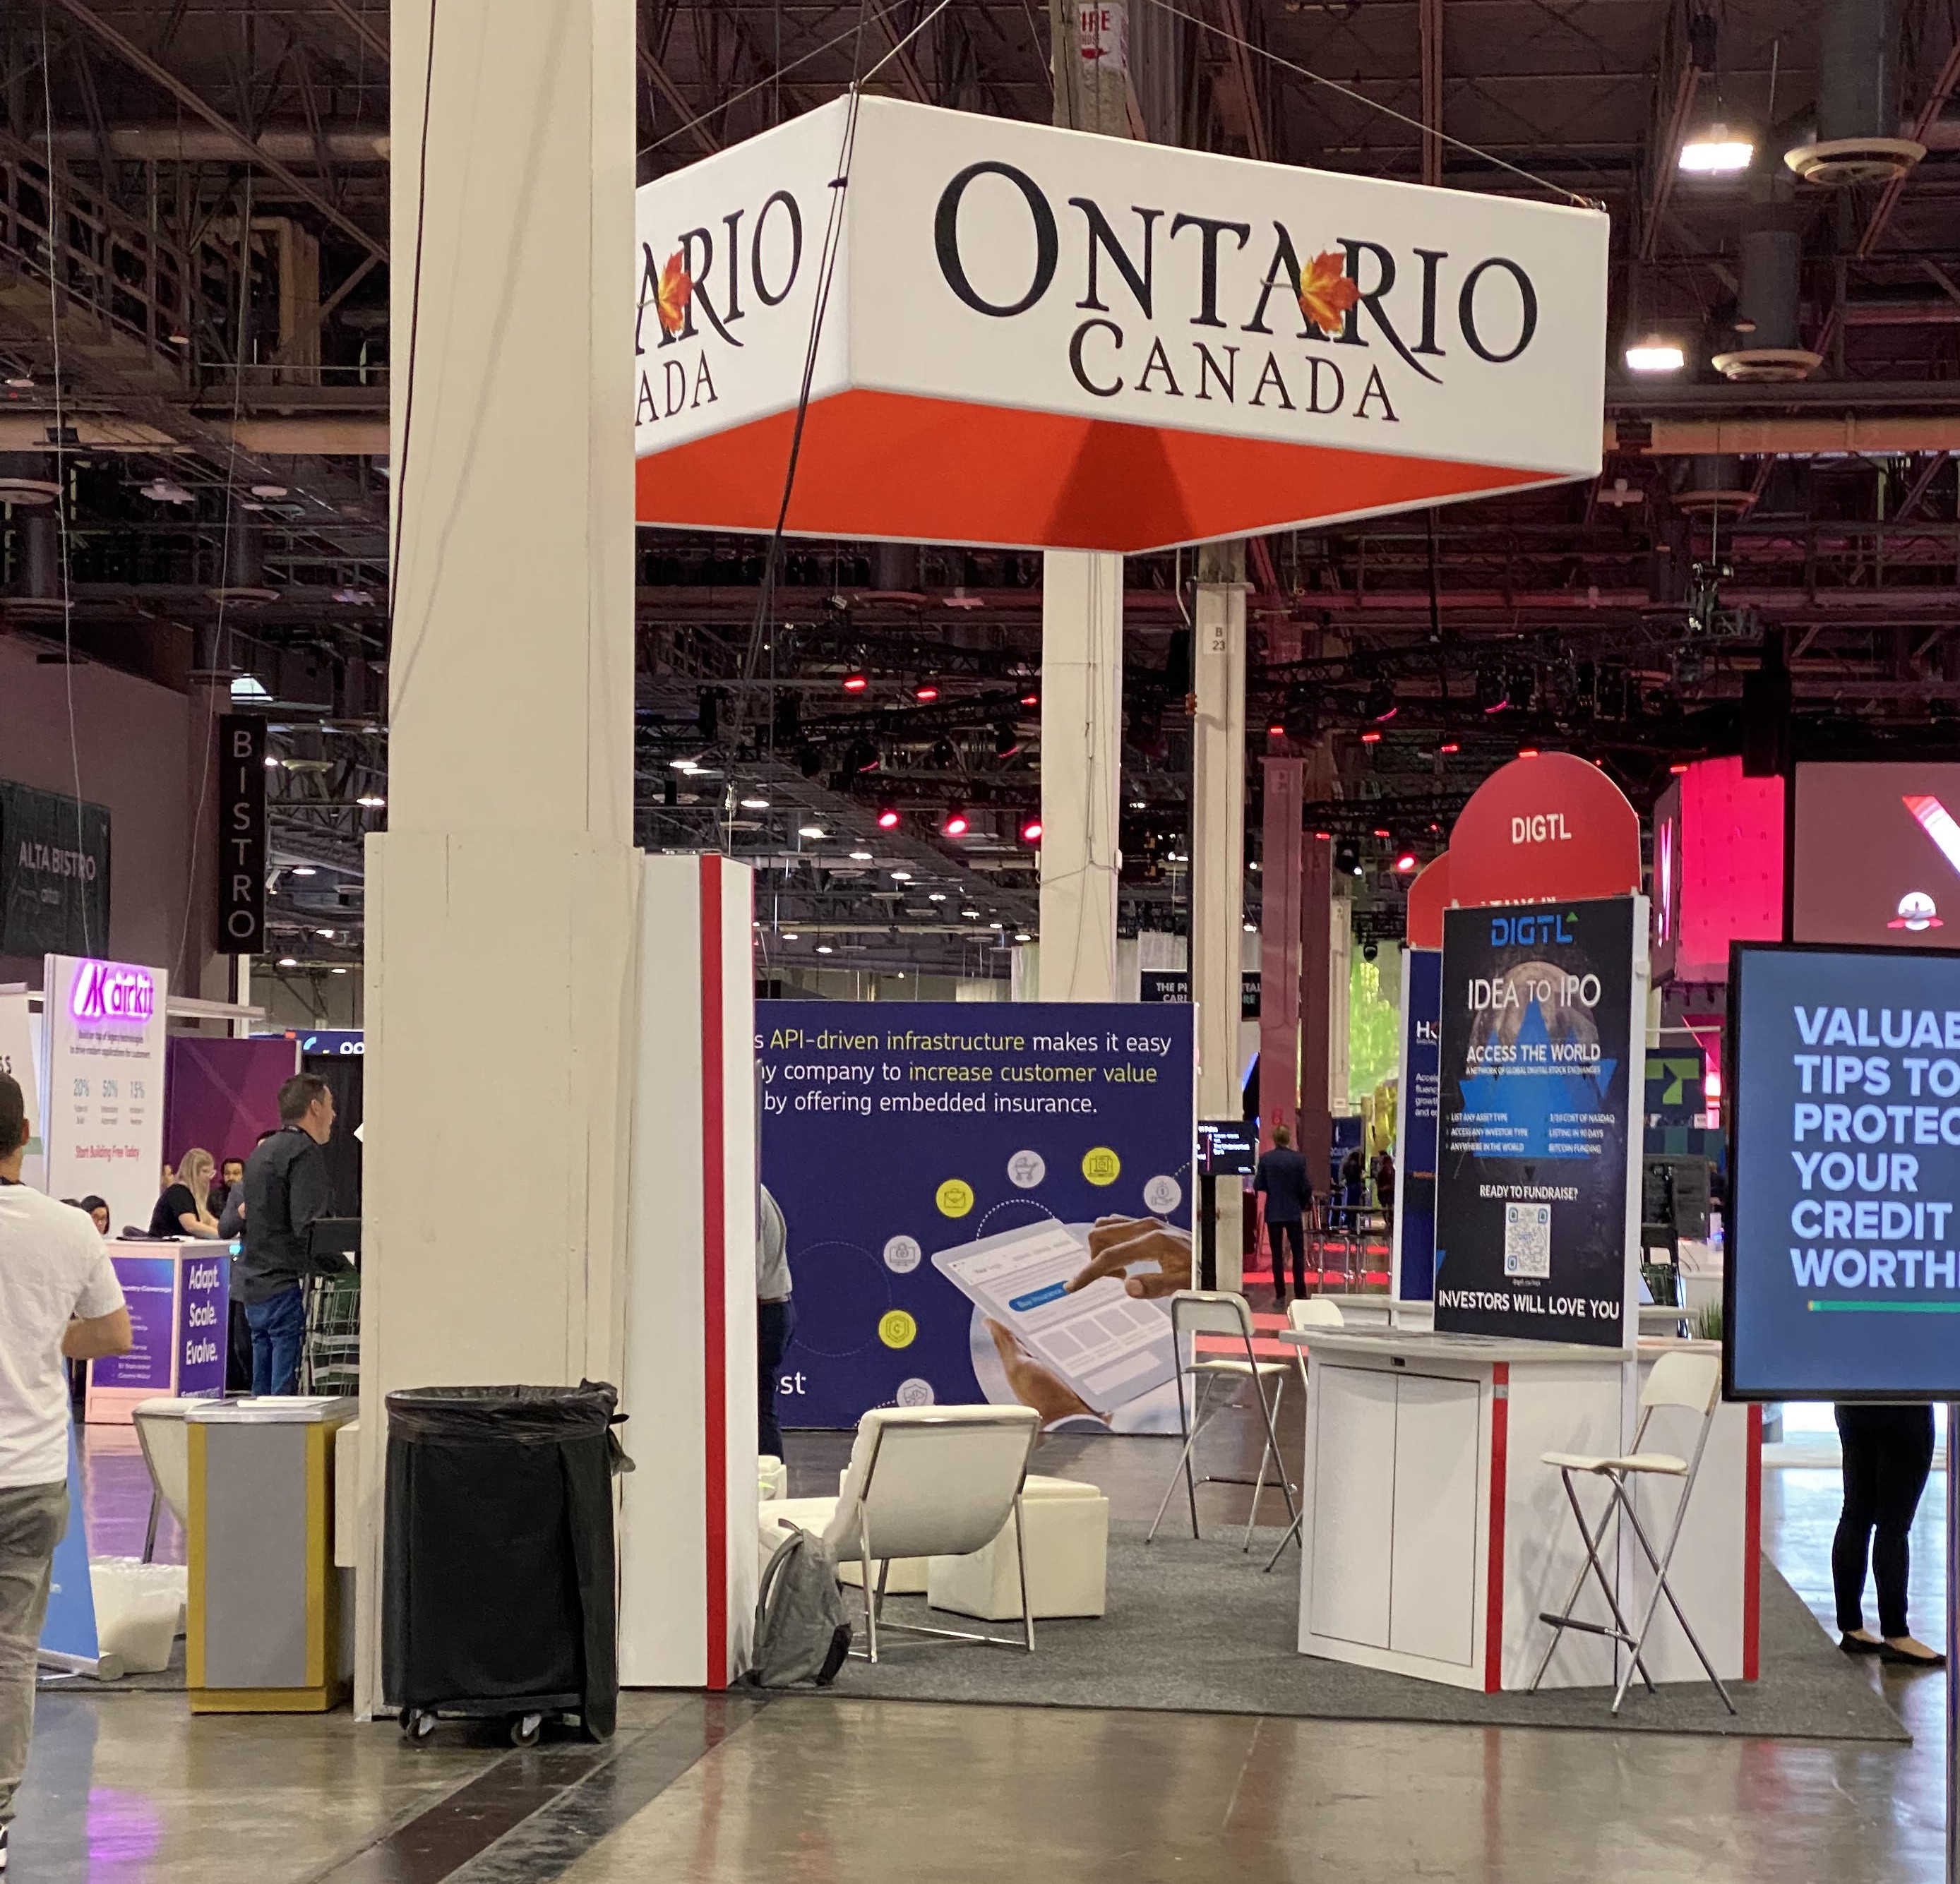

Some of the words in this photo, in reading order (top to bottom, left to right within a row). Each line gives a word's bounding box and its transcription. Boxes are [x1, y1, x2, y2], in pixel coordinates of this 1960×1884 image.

[934, 160, 1538, 385] ONTARIO
[1069, 318, 1400, 422] CANADA
[1212, 640, 1226, 651] 23
[1215, 627, 1223, 637] B
[228, 731, 255, 938] BISTRO
[1511, 813, 1572, 844] DIGTL
[19, 841, 49, 870] ALTA
[52, 848, 96, 880] BISTRO
[1491, 914, 1573, 947] DIGTL
[1156, 982, 1175, 992] THE
[1468, 978, 1519, 1010] IDEA
[1526, 979, 1551, 1002] TO
[1560, 973, 1601, 1008] IPO
[770, 1029, 878, 1050] API-driven
[888, 1031, 1024, 1051] infrastructure
[1033, 1031, 1099, 1052] makes
[1106, 1032, 1119, 1052] it
[1126, 1036, 1172, 1057] easy
[1466, 1045, 1517, 1064] ACCESS
[1520, 1044, 1547, 1062] THE
[1551, 1043, 1601, 1062] WORLD
[784, 1064, 875, 1084] company
[883, 1062, 902, 1081] to
[909, 1061, 993, 1081] increase
[1000, 1064, 1096, 1082] customer
[1103, 1062, 1158, 1084] value
[1794, 1055, 1892, 1096] TIPS
[1903, 1057, 1960, 1098] TO
[764, 1091, 787, 1115] by
[794, 1091, 872, 1115] offering
[880, 1091, 986, 1112] embedded
[994, 1092, 1097, 1114] insurance.
[1792, 1151, 1919, 1192] YOUR
[1479, 1184, 1509, 1198] READY
[1510, 1185, 1523, 1199] TO
[1524, 1186, 1579, 1201] FUNDRAISE?
[1791, 1200, 1953, 1240] CREDIT
[189, 1264, 220, 1294] Adapt.
[1790, 1248, 1960, 1288] WORTH
[189, 1300, 217, 1327] Scale.
[1438, 1290, 1510, 1312] INVESTORS
[1513, 1294, 1546, 1314] WILL
[1548, 1296, 1586, 1318] LOVE
[1589, 1299, 1620, 1321] YOU
[186, 1338, 218, 1365] Evolve.
[776, 1371, 807, 1395] st
